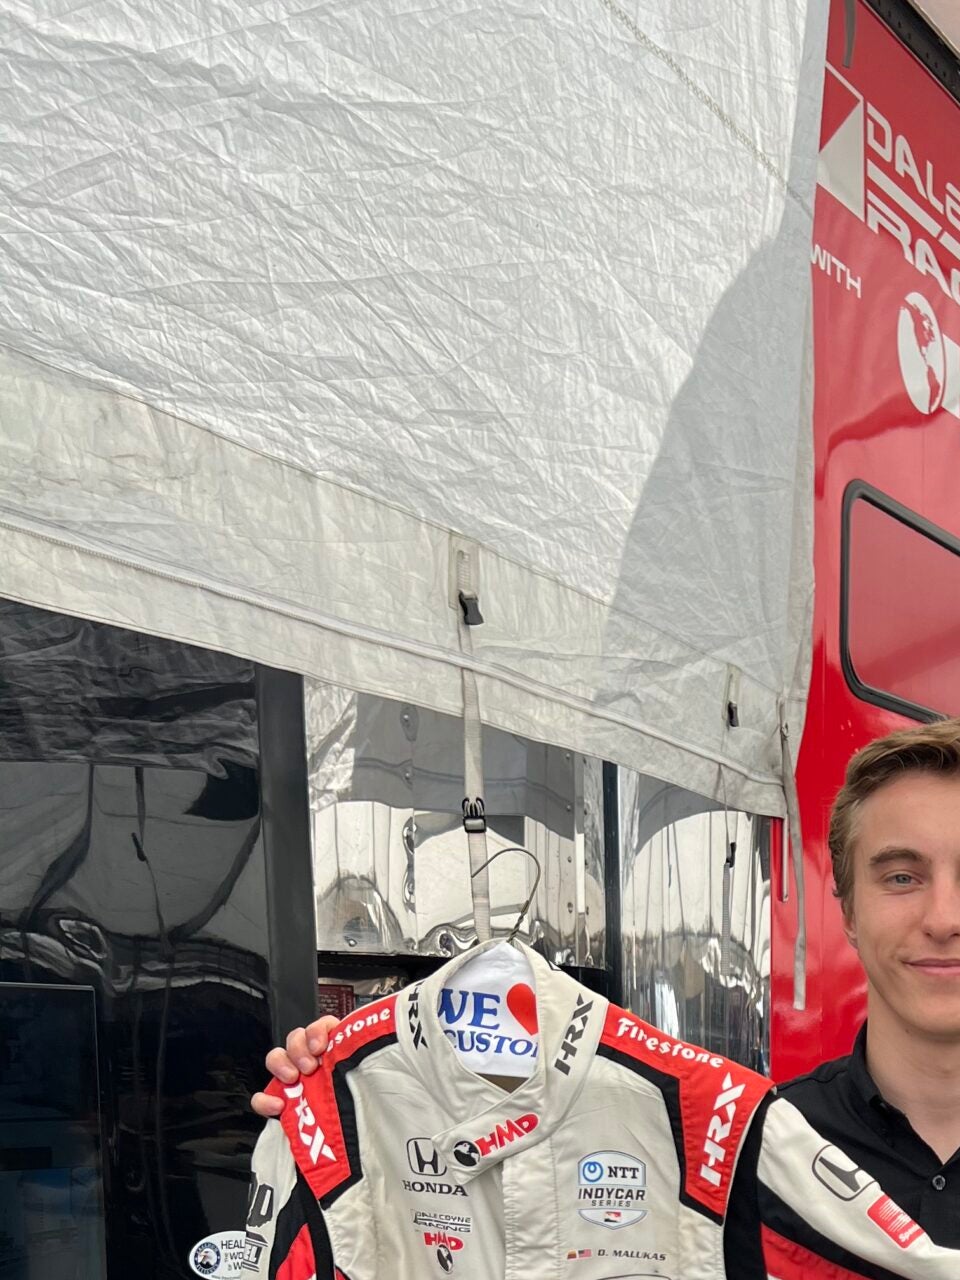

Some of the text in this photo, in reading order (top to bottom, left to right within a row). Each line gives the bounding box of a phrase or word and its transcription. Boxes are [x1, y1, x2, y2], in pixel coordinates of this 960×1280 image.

[811, 243, 862, 299] WITH
[554, 993, 594, 1076] HRX
[616, 1017, 725, 1069] Firestone
[474, 1113, 540, 1157] HMD
[700, 1072, 746, 1188] HRX
[607, 1166, 640, 1179] NTT
[402, 1179, 469, 1197] HONDA
[578, 1188, 646, 1201] INDYCAR
[591, 1200, 632, 1208] SERIES
[423, 1231, 464, 1251] HMD
[598, 1249, 667, 1261] D. MALUKAS
